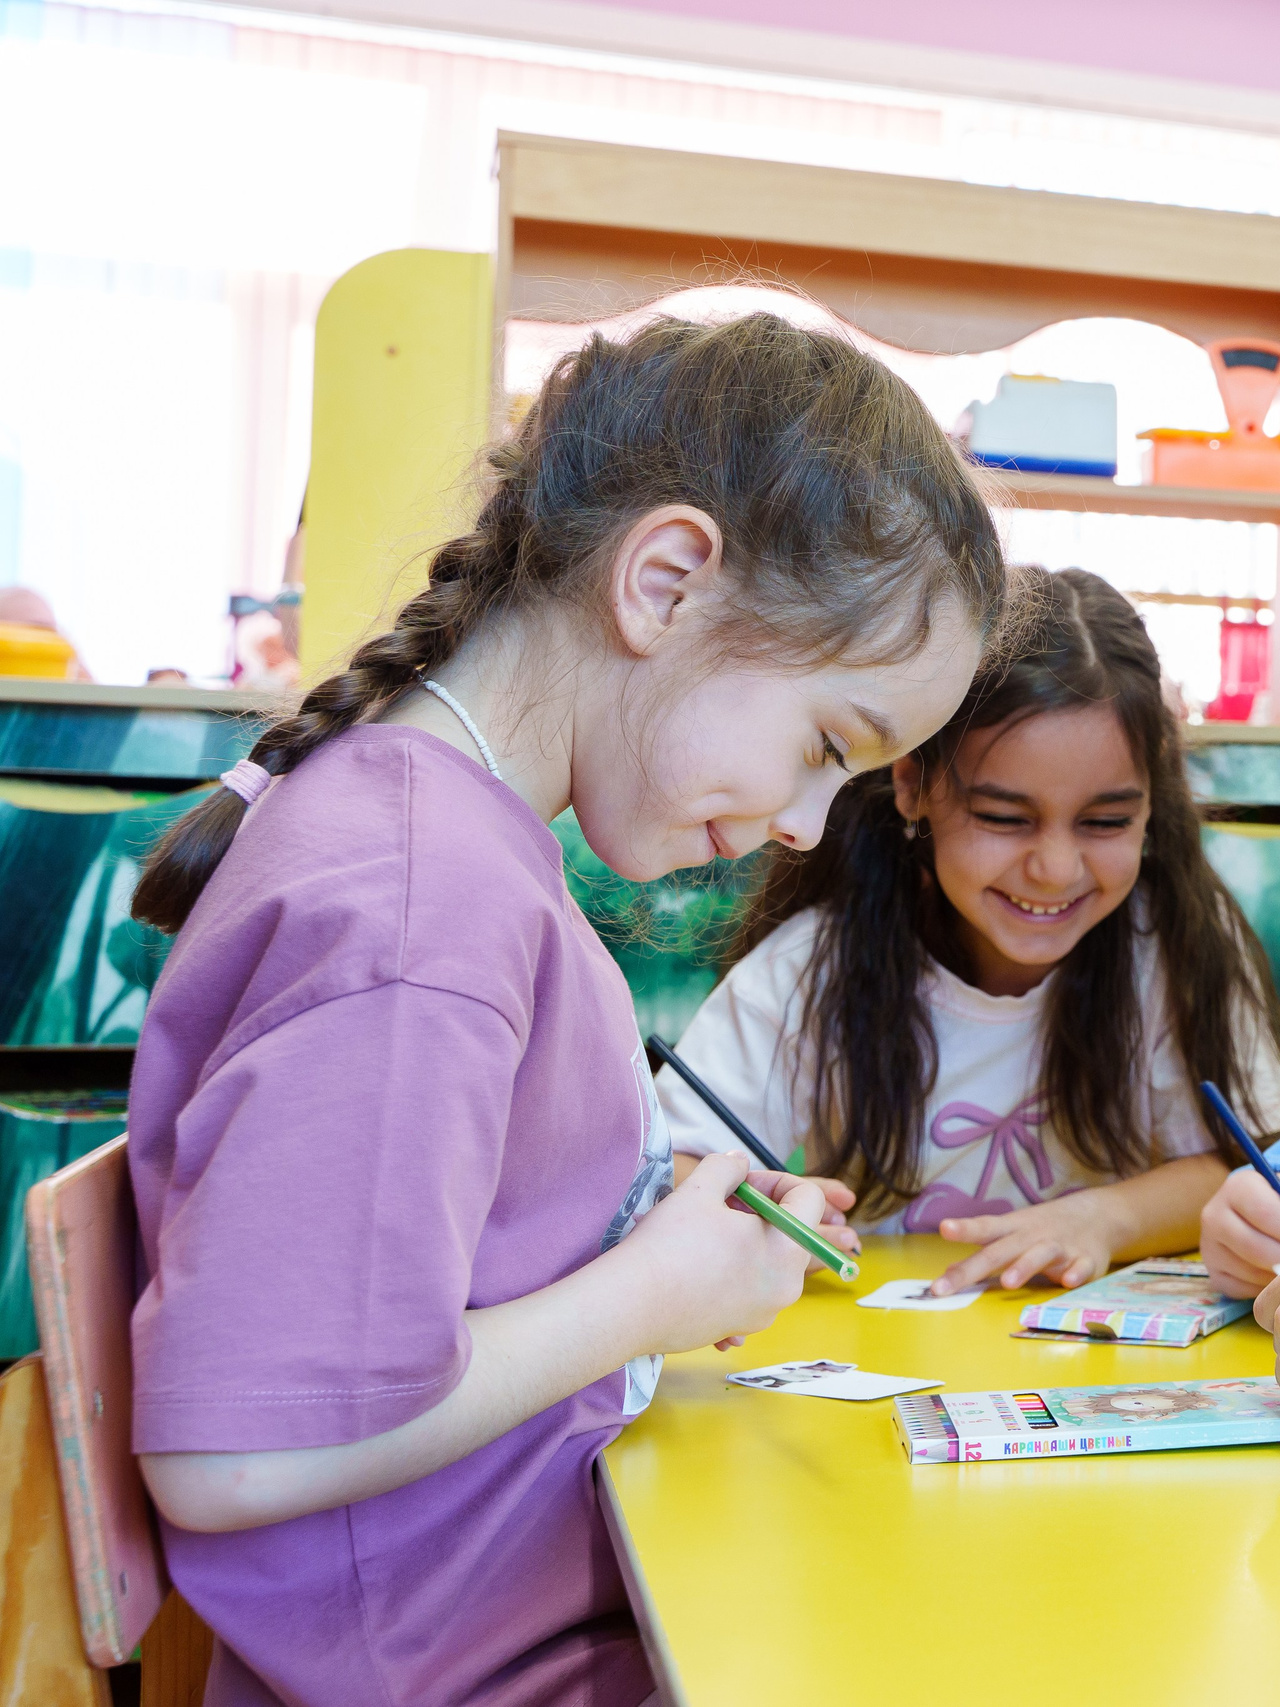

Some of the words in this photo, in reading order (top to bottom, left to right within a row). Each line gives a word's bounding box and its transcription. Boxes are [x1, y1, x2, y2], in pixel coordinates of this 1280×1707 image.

[965, 1442, 982, 1461] 12
[1004, 1439, 1076, 1455] КАРАНДАШИ
[1080, 1435, 1132, 1452] ЦВЕТНЫЕ
